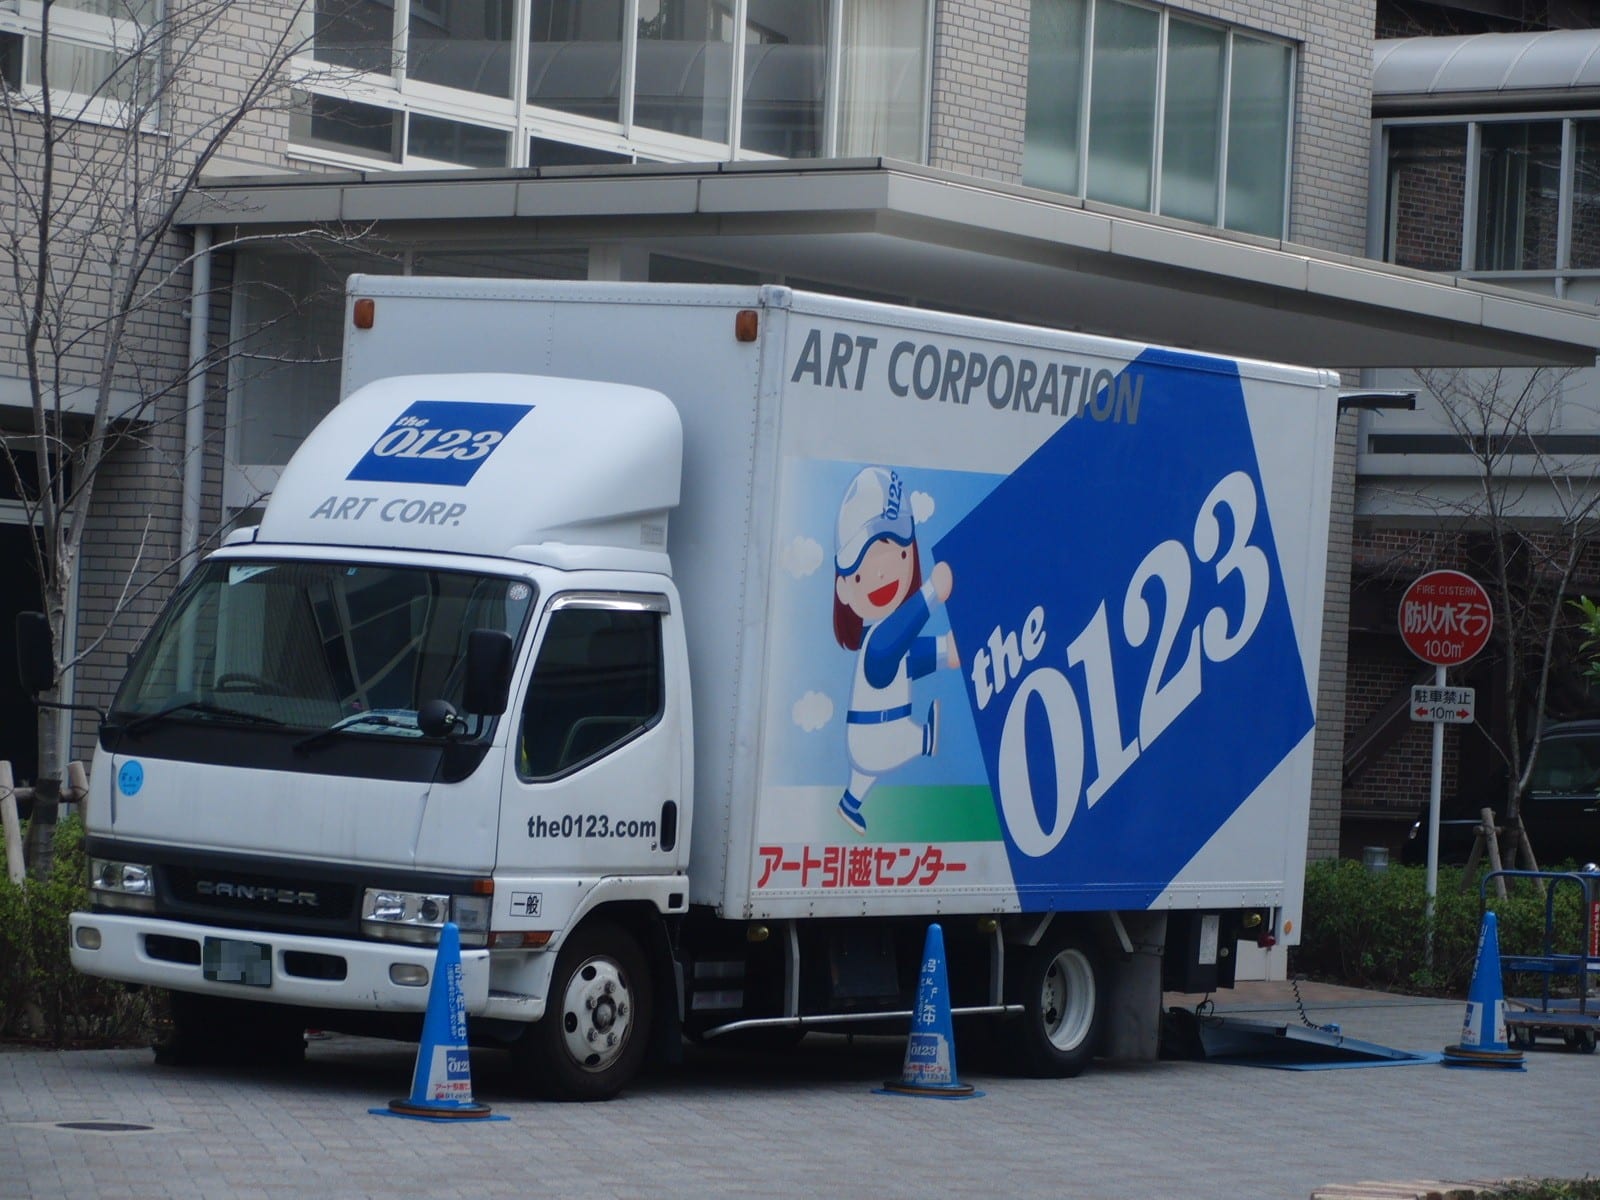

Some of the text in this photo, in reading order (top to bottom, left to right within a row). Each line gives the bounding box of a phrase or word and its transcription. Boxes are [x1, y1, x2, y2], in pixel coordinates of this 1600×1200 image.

[791, 328, 1144, 425] ART CORPORATION
[394, 415, 430, 428] the
[373, 427, 503, 461] 0123
[309, 496, 467, 527] ART CORP.
[1416, 584, 1477, 596] FIRE CISTERN
[971, 605, 1047, 711] the
[998, 470, 1270, 858] 0123
[1414, 689, 1471, 705] 駐車禁止
[1429, 707, 1455, 720] 10m
[527, 814, 657, 838] the0123.com
[757, 845, 967, 889] アート引越センター
[197, 880, 320, 906] CANTER
[513, 895, 539, 915] 一般
[448, 1060, 470, 1073] 012
